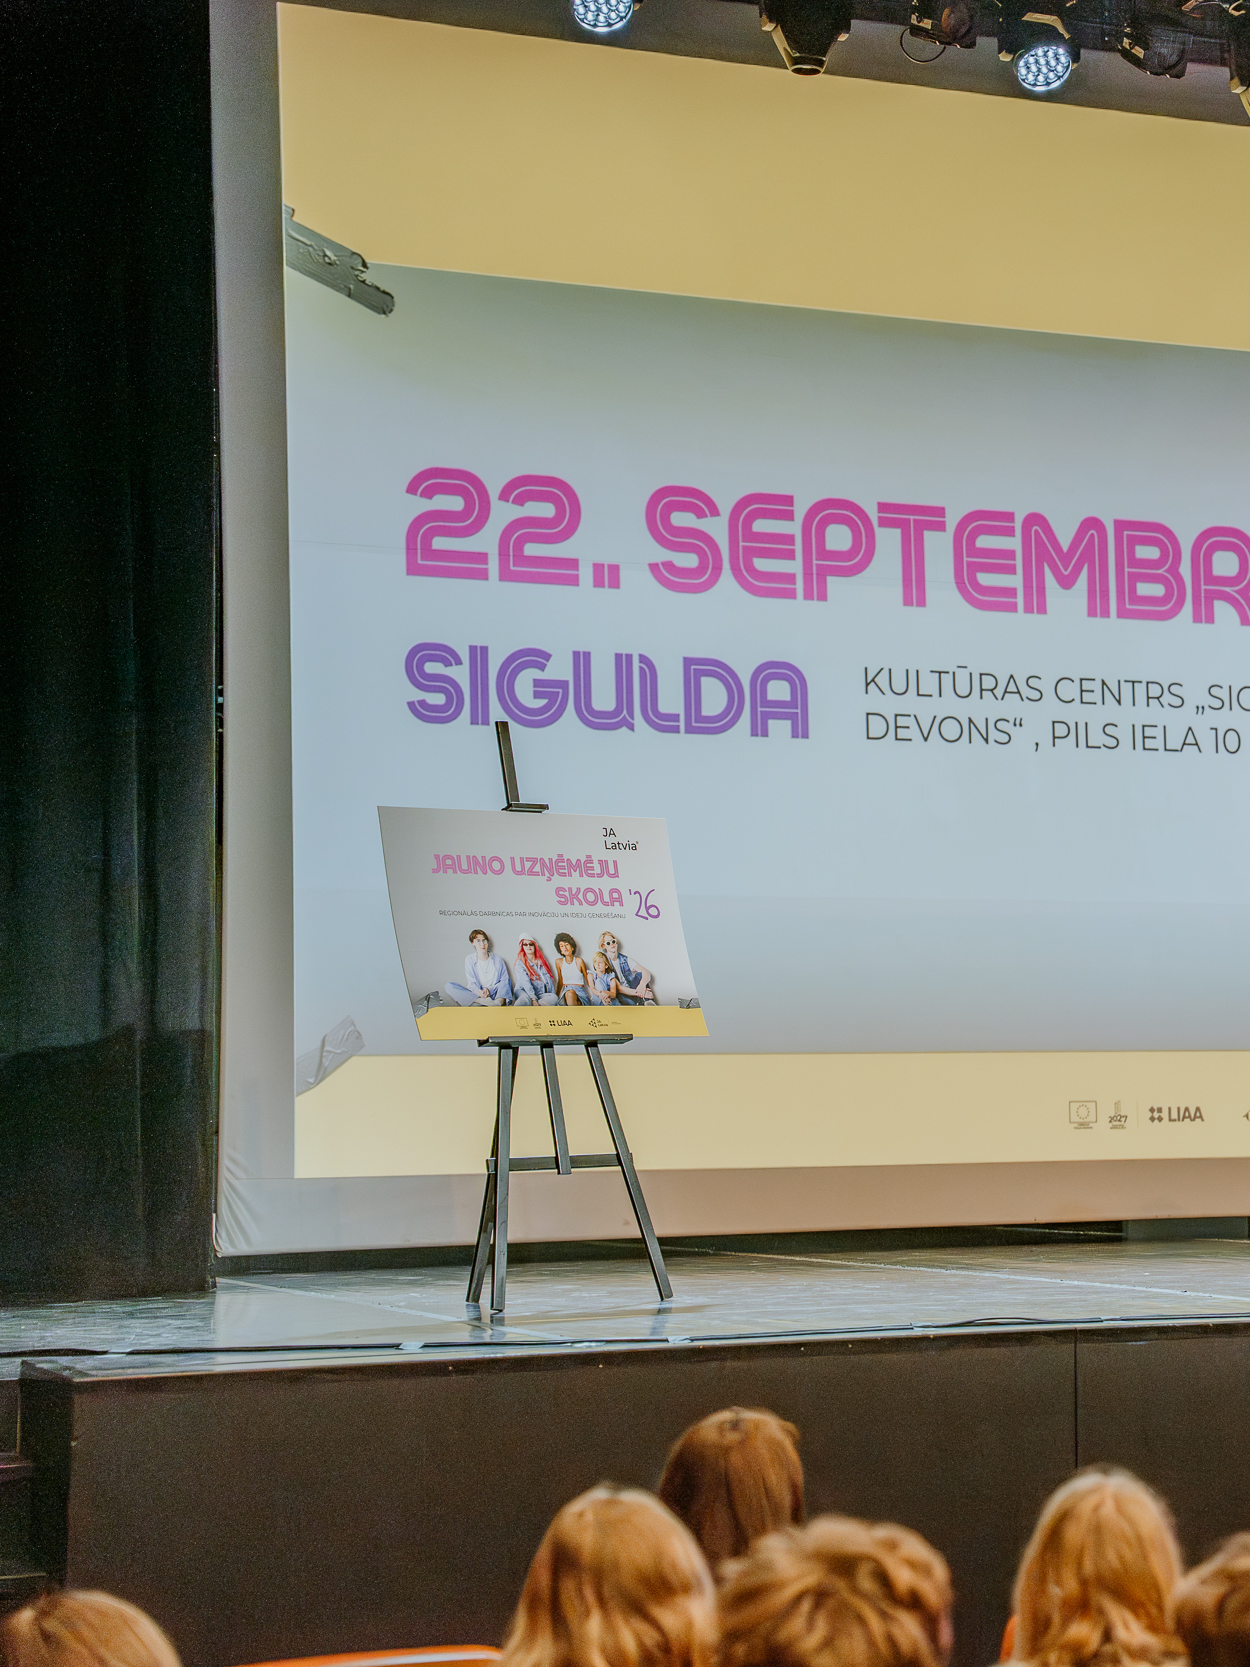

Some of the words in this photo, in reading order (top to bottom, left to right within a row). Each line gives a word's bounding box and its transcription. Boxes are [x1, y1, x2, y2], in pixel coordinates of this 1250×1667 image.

[405, 466, 621, 590] 22.
[404, 642, 810, 739] SIGULDA
[863, 665, 1044, 702] KULTŪRAS
[1054, 676, 1186, 709] CENTRS
[1051, 719, 1120, 751] PILS
[1131, 723, 1203, 755] IELA
[1211, 727, 1243, 756] 10
[602, 827, 617, 838] JA
[431, 853, 505, 876] JAUNO
[509, 853, 620, 882] UZŅĒMĒJU
[554, 886, 624, 908] SKOLA
[556, 1019, 573, 1027] LIAA
[1108, 1113, 1128, 1124] 2027
[1167, 1106, 1205, 1123] LIAA
